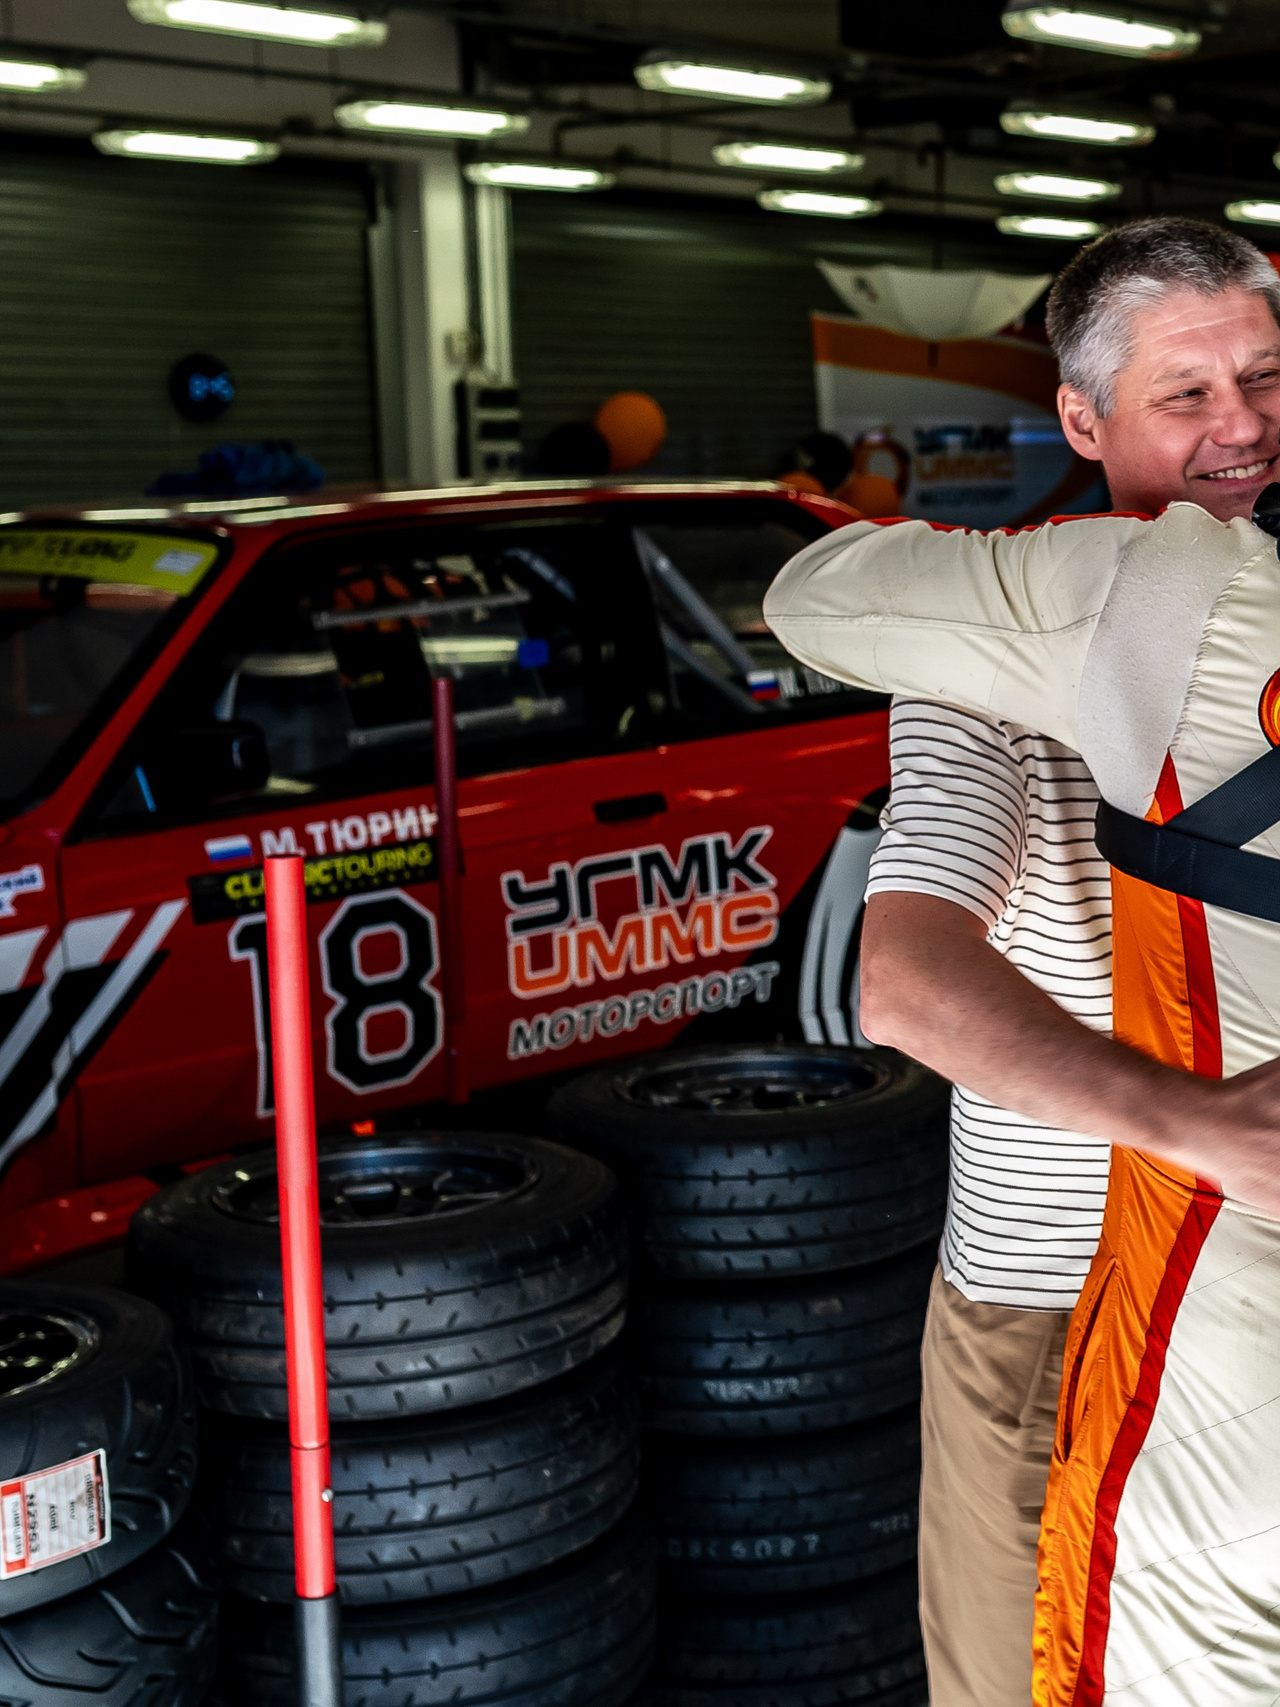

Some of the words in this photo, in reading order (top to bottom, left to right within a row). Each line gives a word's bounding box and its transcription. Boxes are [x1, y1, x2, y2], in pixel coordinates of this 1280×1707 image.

[500, 824, 778, 938] УГМК
[507, 890, 780, 999] UMMC
[227, 887, 445, 1119] 18
[507, 960, 780, 1061] МОТОРСПОРТ
